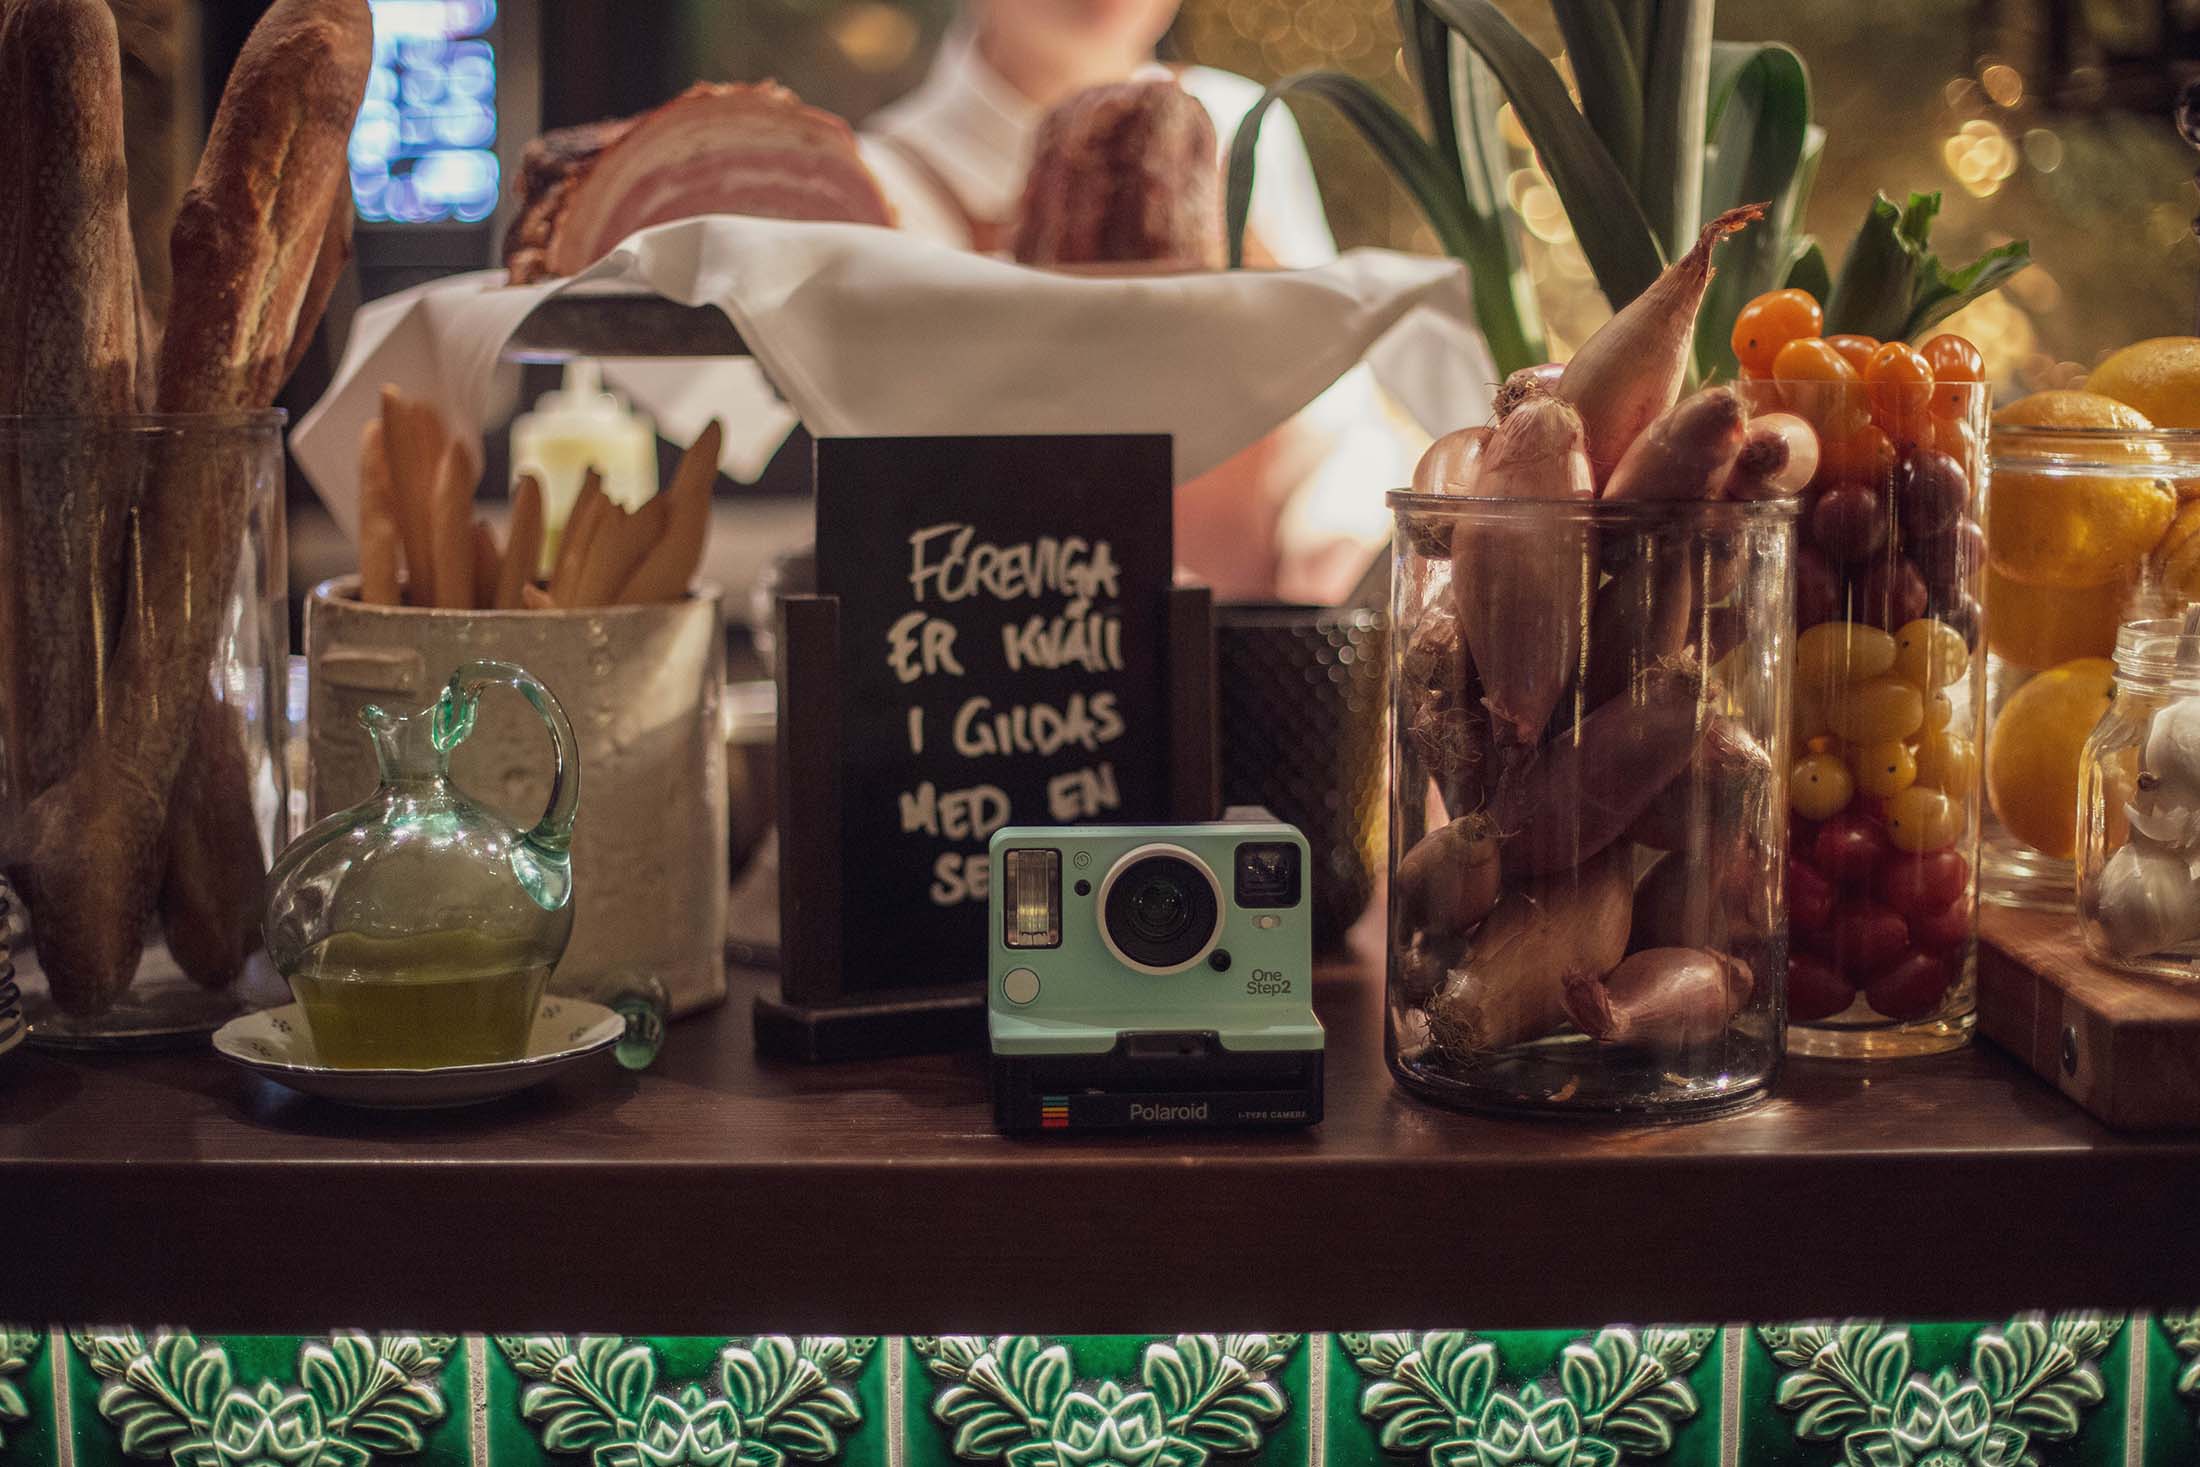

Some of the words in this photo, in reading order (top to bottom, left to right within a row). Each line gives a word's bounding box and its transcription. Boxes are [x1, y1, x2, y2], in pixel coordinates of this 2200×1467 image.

[887, 611, 965, 684] ER
[908, 705, 924, 754] I
[952, 692, 1125, 757] GILDAS
[899, 781, 1011, 839] MED
[1047, 761, 1120, 821] EN
[1247, 980, 1291, 997] Step2
[1252, 968, 1282, 982] One
[1130, 1103, 1208, 1121] Polaroid
